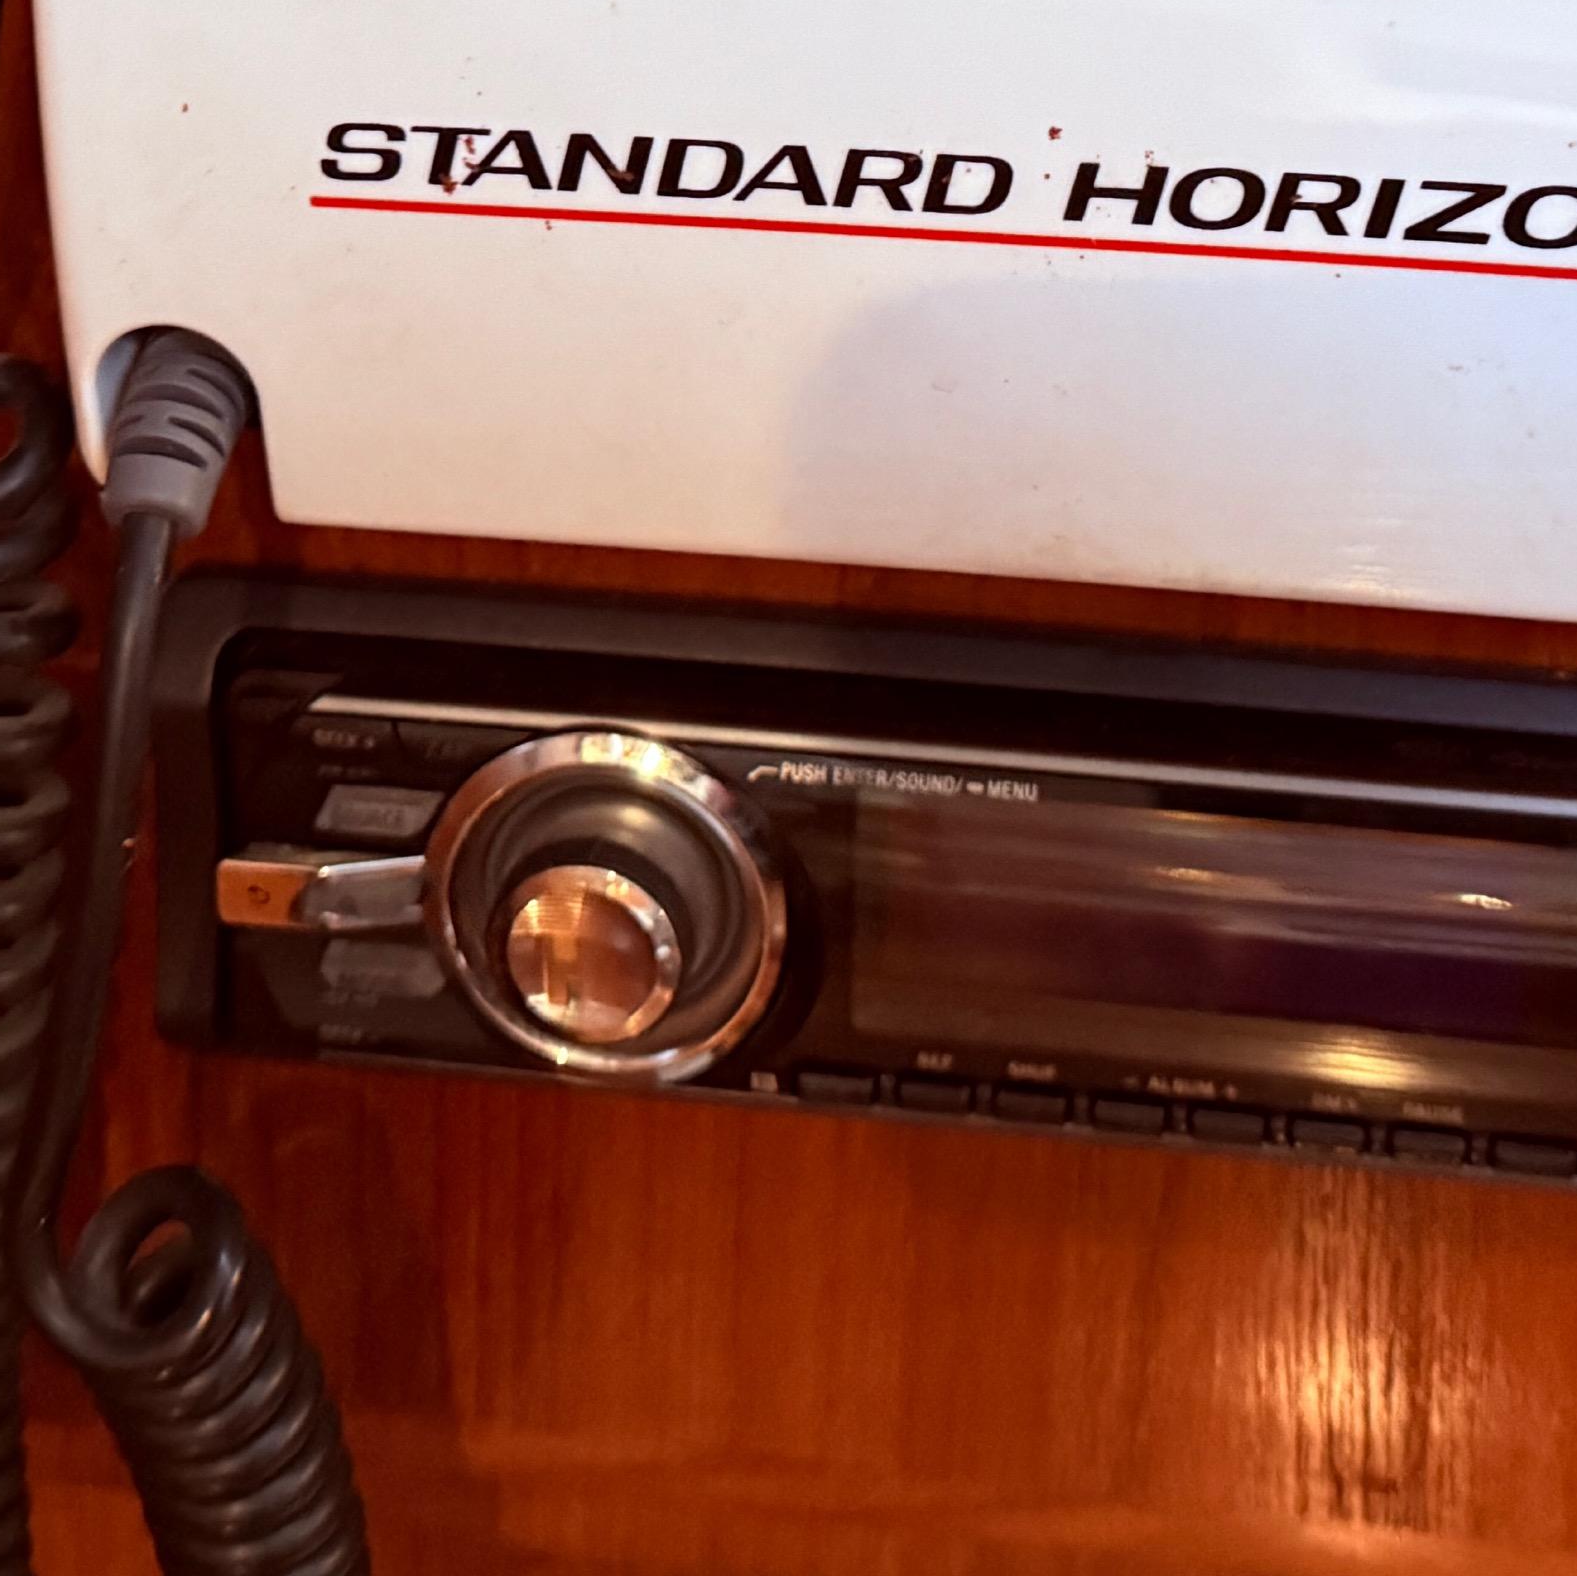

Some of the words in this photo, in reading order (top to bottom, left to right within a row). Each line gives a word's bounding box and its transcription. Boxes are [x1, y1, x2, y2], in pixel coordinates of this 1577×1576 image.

[319, 121, 1016, 216] STANDARD
[778, 760, 828, 785] PUSH
[986, 779, 1040, 804] MENU
